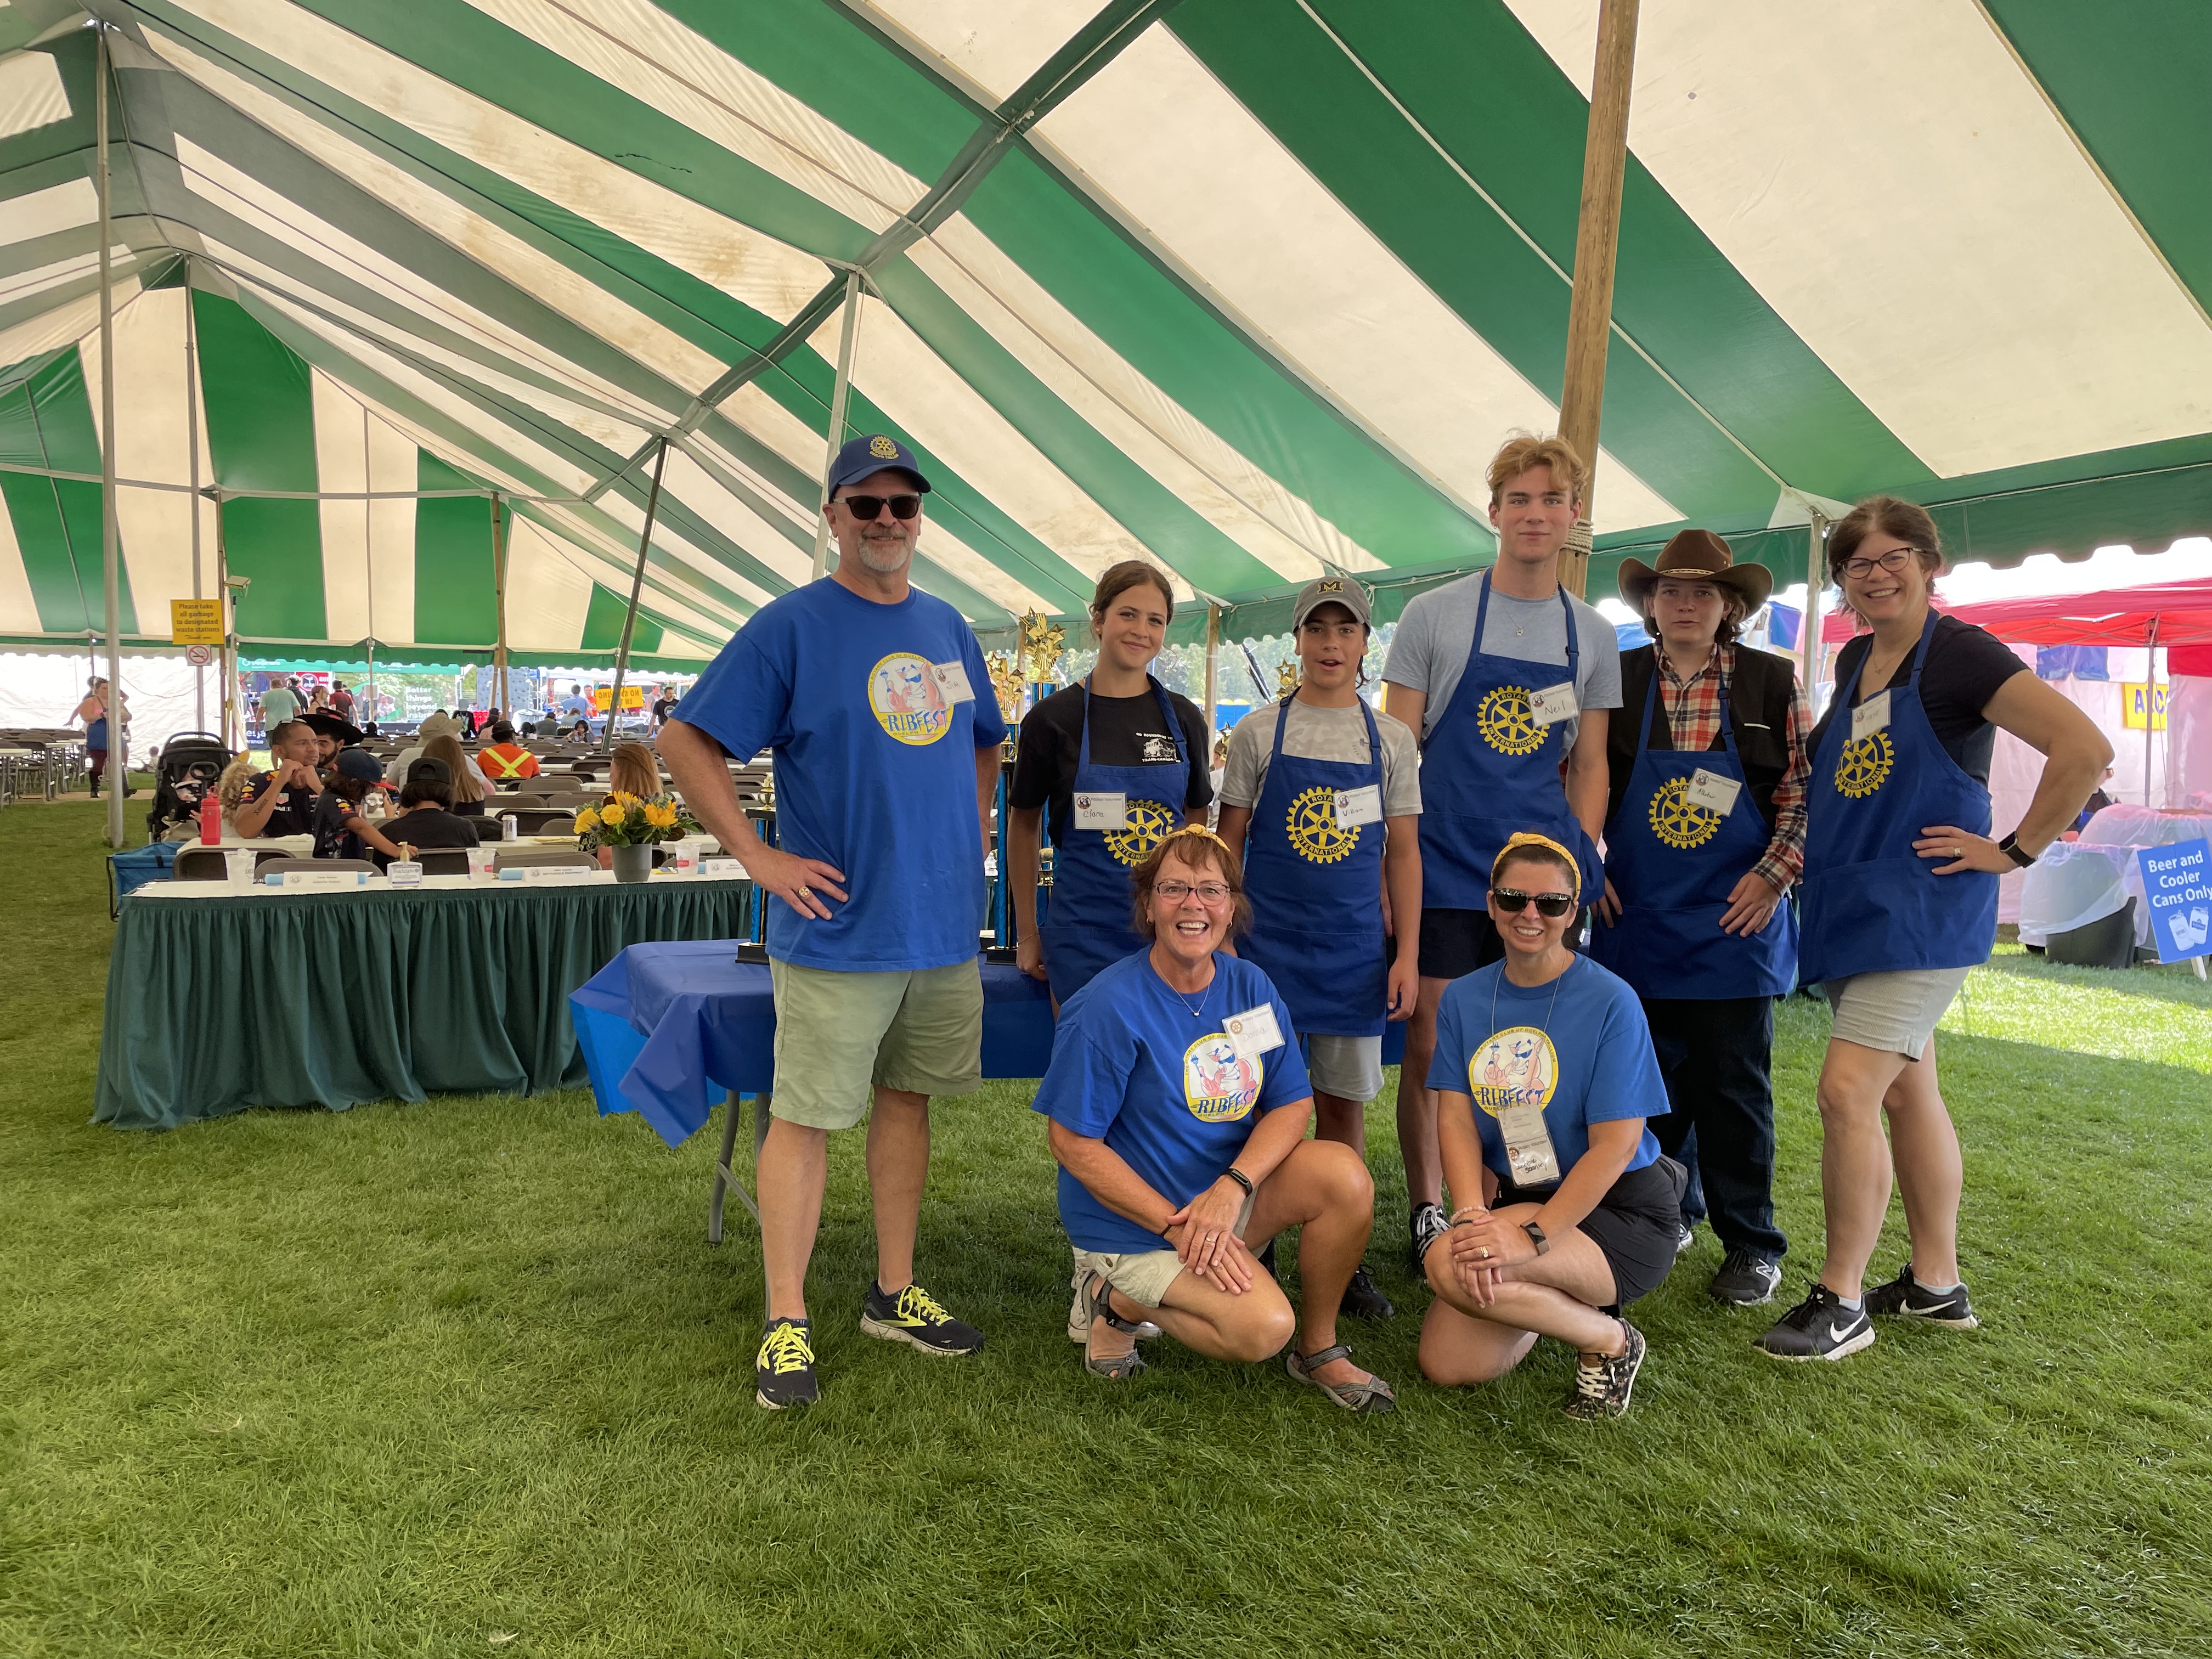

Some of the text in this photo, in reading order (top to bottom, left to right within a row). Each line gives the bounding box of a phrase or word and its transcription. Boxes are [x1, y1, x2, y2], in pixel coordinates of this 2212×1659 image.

[1317, 581, 1344, 594] M
[872, 663, 882, 680] ROTARY
[946, 681, 960, 690] JIM
[405, 695, 432, 703] things
[1501, 693, 1527, 702] ROTAR
[406, 703, 437, 711] beyond
[1545, 700, 1566, 715] Neil
[887, 709, 947, 733] RIBFEST
[1487, 726, 1539, 748] INTERNATIONAL
[1083, 809, 1104, 819] Clara
[1659, 823, 1711, 841] INTERNATIONAL
[1296, 833, 1351, 856] INTERNATIONAL
[2147, 849, 2204, 873] Beer and
[2159, 871, 2200, 889] Cooler
[2152, 893, 2184, 908] Cans
[1240, 1026, 1268, 1042] Donna
[1194, 1037, 1206, 1048] CLUB
[1545, 1039, 1556, 1063] TRILLIUM
[1198, 1087, 1256, 1114] RIBFEST
[1531, 1139, 1547, 1148] Volunteer
